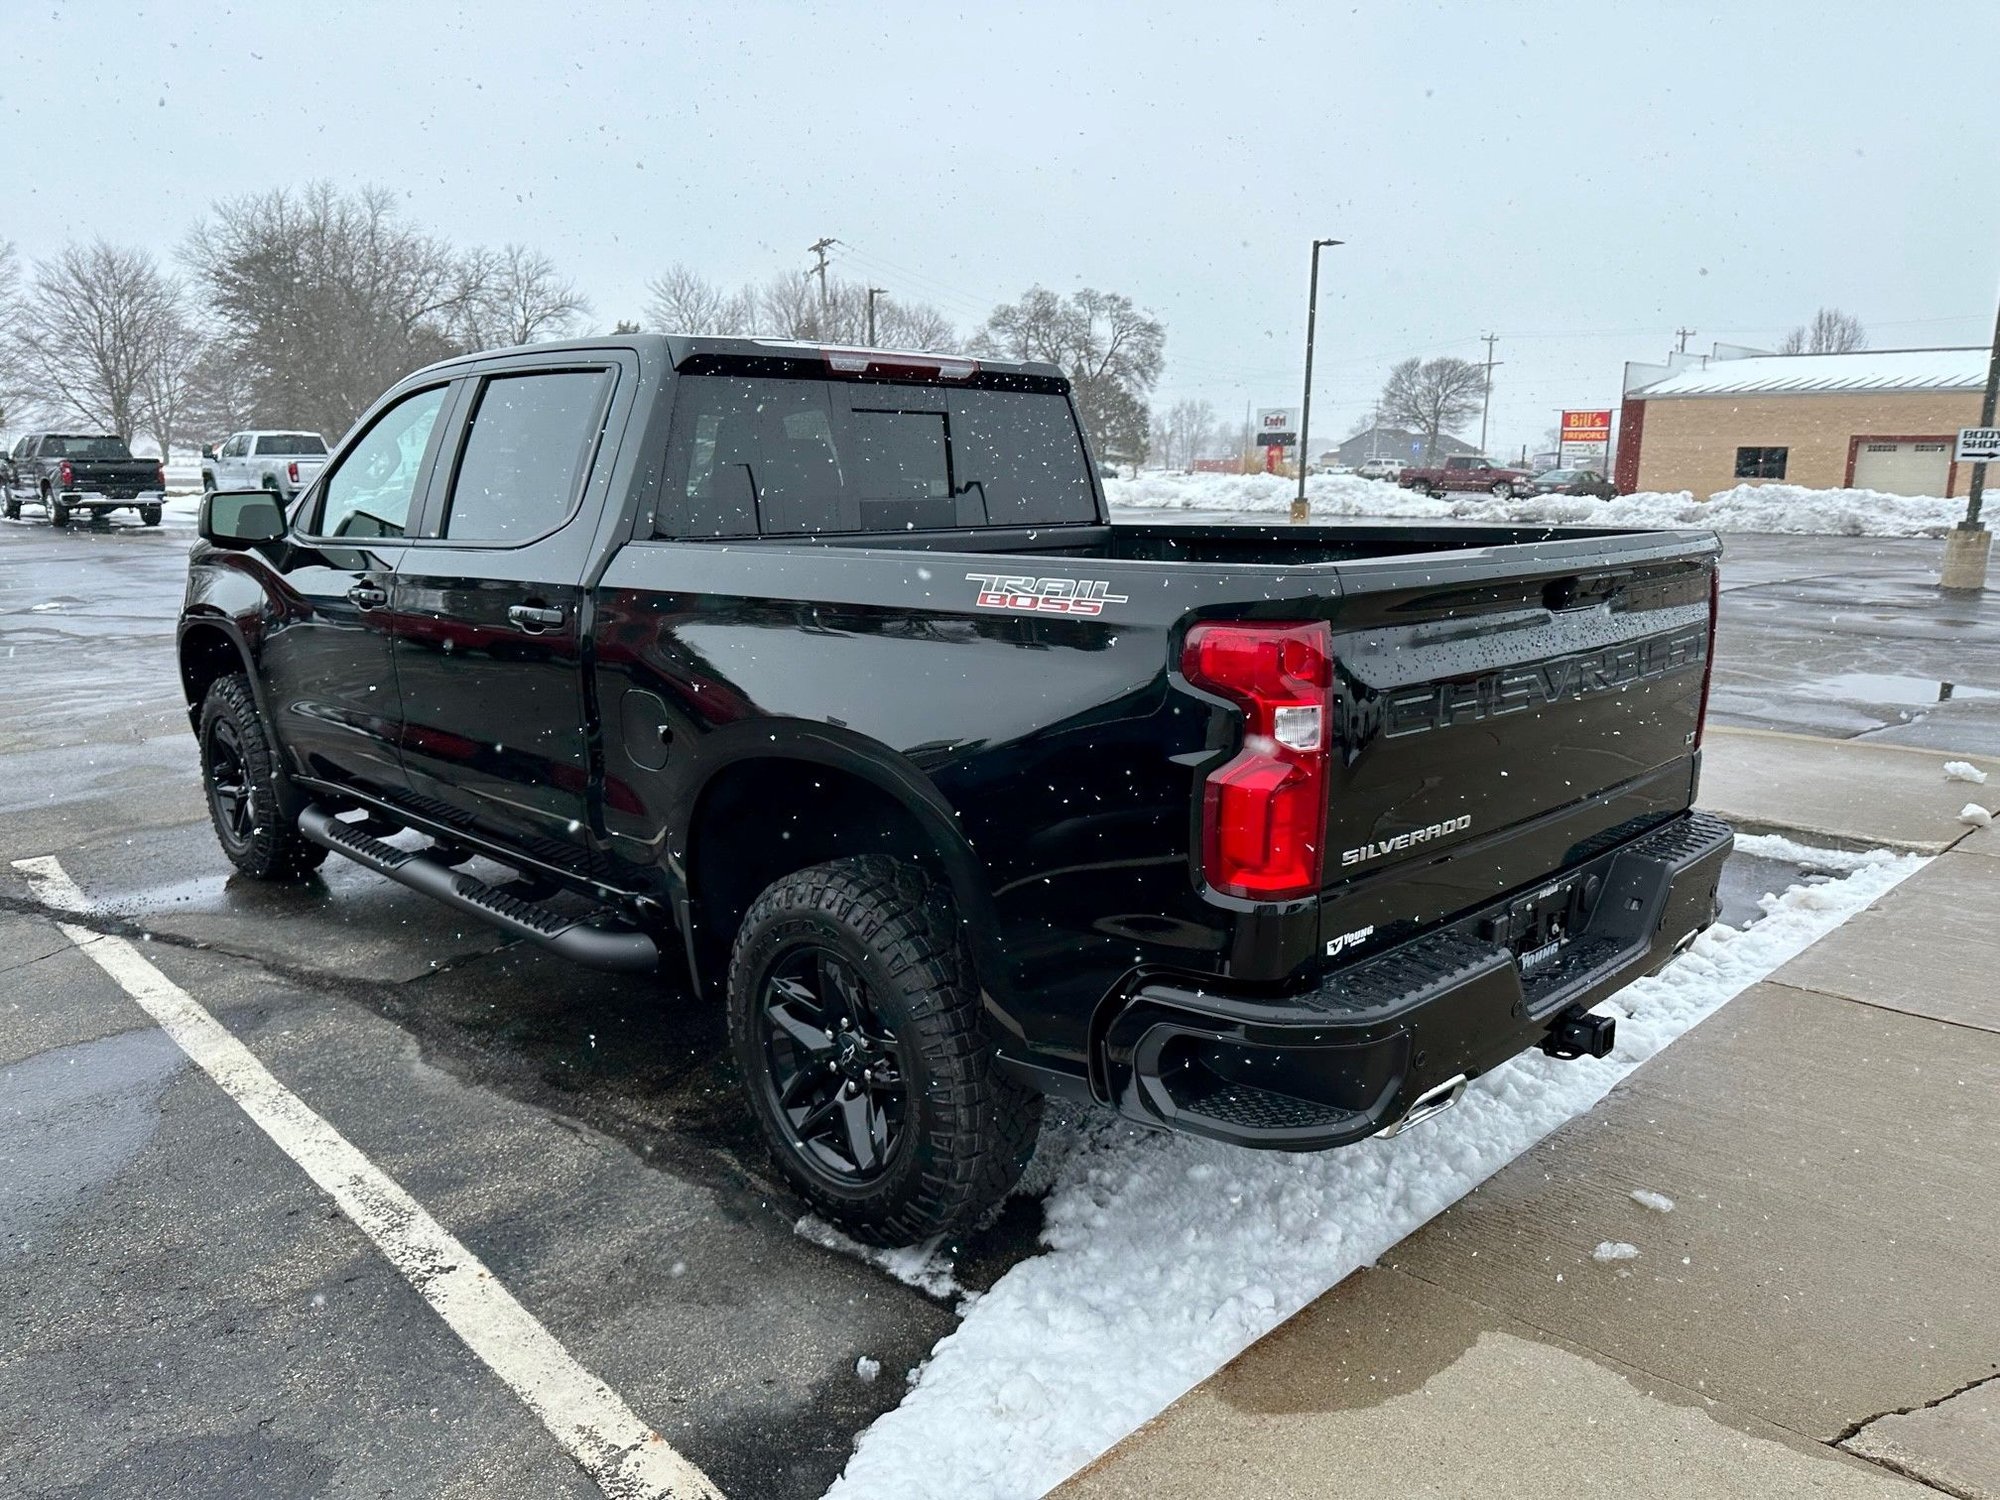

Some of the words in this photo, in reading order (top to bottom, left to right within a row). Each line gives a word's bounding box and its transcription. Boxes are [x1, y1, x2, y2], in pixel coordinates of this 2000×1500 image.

[1569, 413, 1602, 427] Bill's
[1563, 431, 1607, 440] FIREWORKS
[965, 573, 1129, 603] TRAIL
[976, 592, 1103, 616] BOSS
[1341, 814, 1471, 867] SILVERADO
